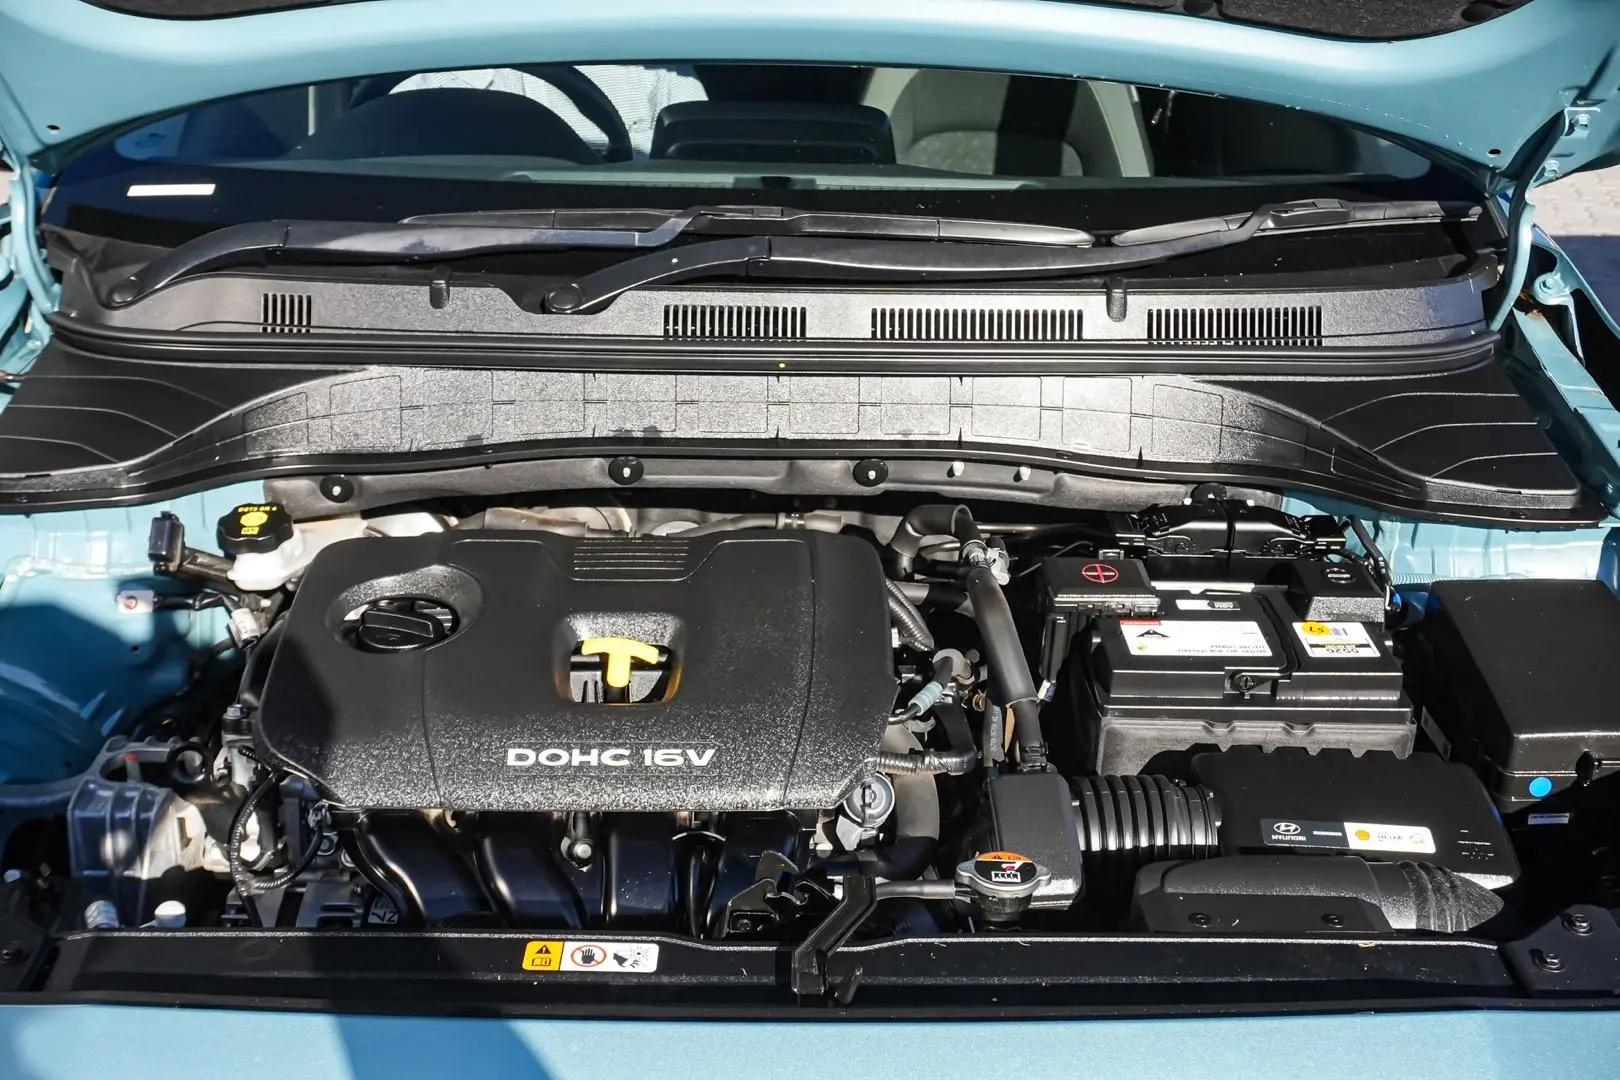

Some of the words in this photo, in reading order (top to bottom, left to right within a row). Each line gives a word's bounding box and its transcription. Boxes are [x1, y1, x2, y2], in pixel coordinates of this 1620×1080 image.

[506, 748, 631, 767] DOHC
[643, 748, 716, 767] 16V
[1271, 833, 1307, 842] HYUNDAI
